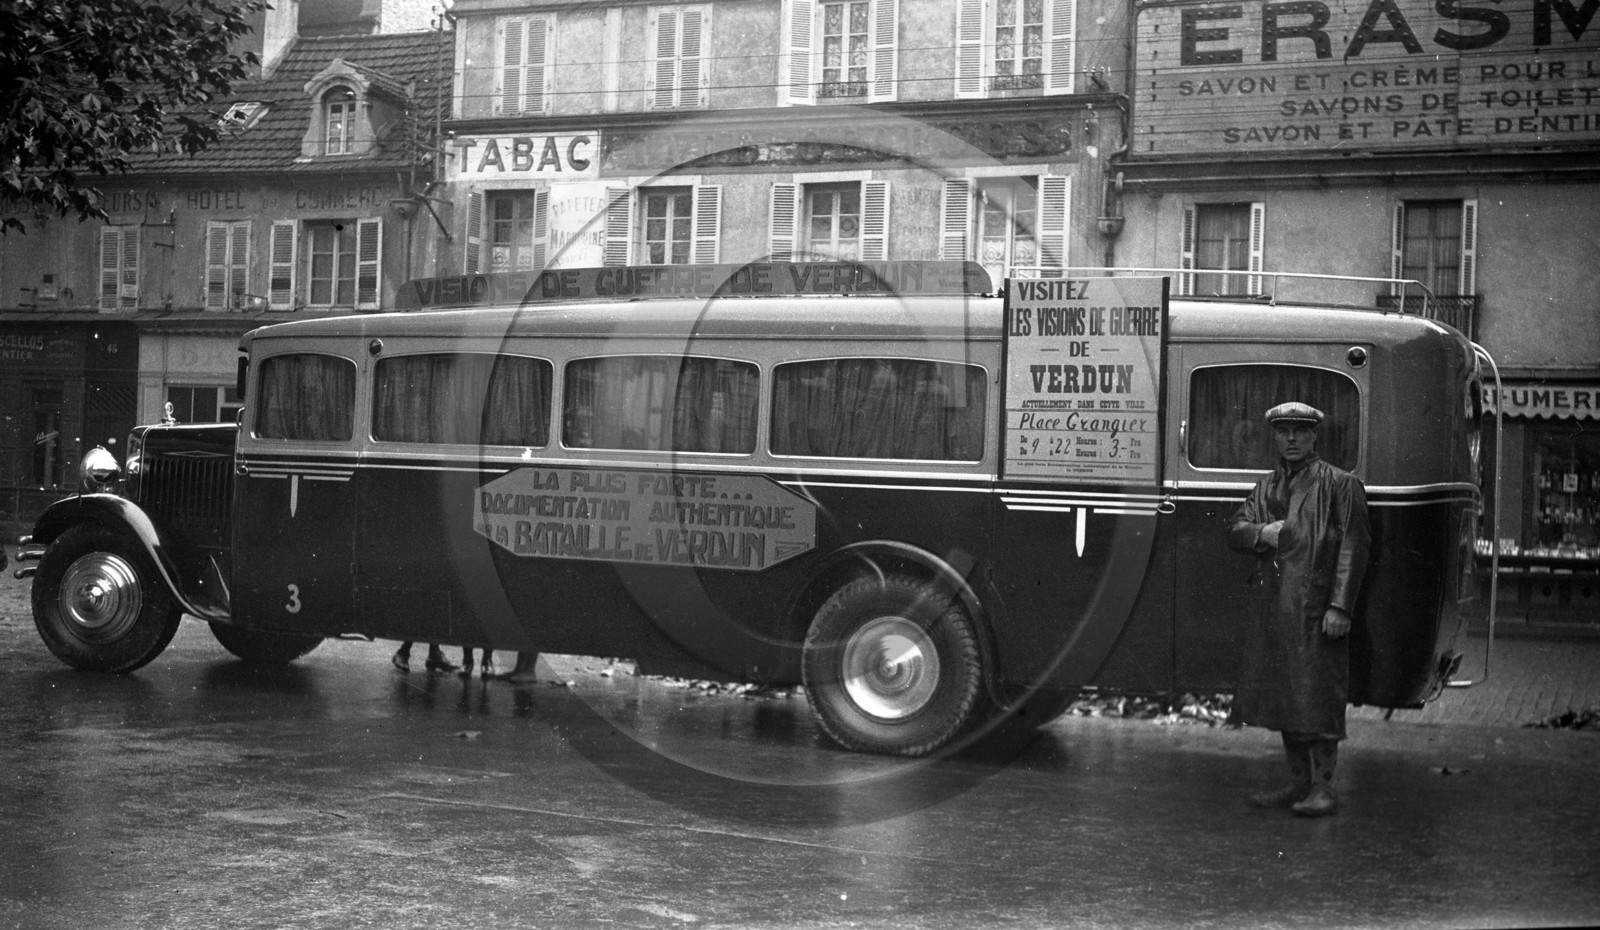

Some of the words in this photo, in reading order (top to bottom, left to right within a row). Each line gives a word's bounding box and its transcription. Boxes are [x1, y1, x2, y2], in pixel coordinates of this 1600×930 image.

[1181, 0, 1600, 66] ERASM
[1178, 76, 1277, 96] SAVON
[1294, 73, 1331, 91] ET
[1350, 65, 1459, 88] CRÈME
[1480, 62, 1566, 82] POUR
[1280, 95, 1404, 117] SAVONS
[1422, 92, 1459, 111] DE
[1480, 87, 1600, 109] TOILET
[1224, 124, 1320, 144] SAVON
[1338, 122, 1374, 140] ET
[1393, 113, 1473, 138] PÂTE
[452, 135, 591, 173] TABAC
[186, 189, 246, 210] HOTEL
[413, 273, 526, 306] VISIONS
[541, 269, 581, 298] DE
[594, 267, 714, 296] GUERRE
[730, 265, 772, 293] DE
[788, 263, 923, 293] VERDUN
[1018, 280, 1090, 301] VISITEZ
[1009, 307, 1032, 337] LES
[1036, 307, 1086, 337] VISIONS
[1089, 307, 1106, 337] DE
[1109, 306, 1160, 337] GUERRE
[0, 349, 33, 361] NTIER
[1069, 341, 1090, 357] DE
[1029, 364, 1134, 394] VERDUN
[1021, 400, 1072, 409] ACTUELLEMENT
[1077, 400, 1095, 409] DANS
[1099, 400, 1120, 409] CETTE
[1125, 400, 1145, 409] VILLE
[1019, 412, 1061, 430] Place
[1065, 411, 1148, 439] Grangier
[1032, 437, 1040, 454] 9
[1055, 437, 1071, 454] 22
[533, 470, 559, 491] LA
[570, 471, 626, 494] PLUS
[481, 491, 630, 521] DOCUMENTATION
[649, 500, 796, 530] AUTHENTIQUE
[514, 520, 632, 560] BATAILLE
[634, 543, 653, 561] DE
[655, 528, 766, 568] VERDUN
[285, 583, 302, 615] 3
